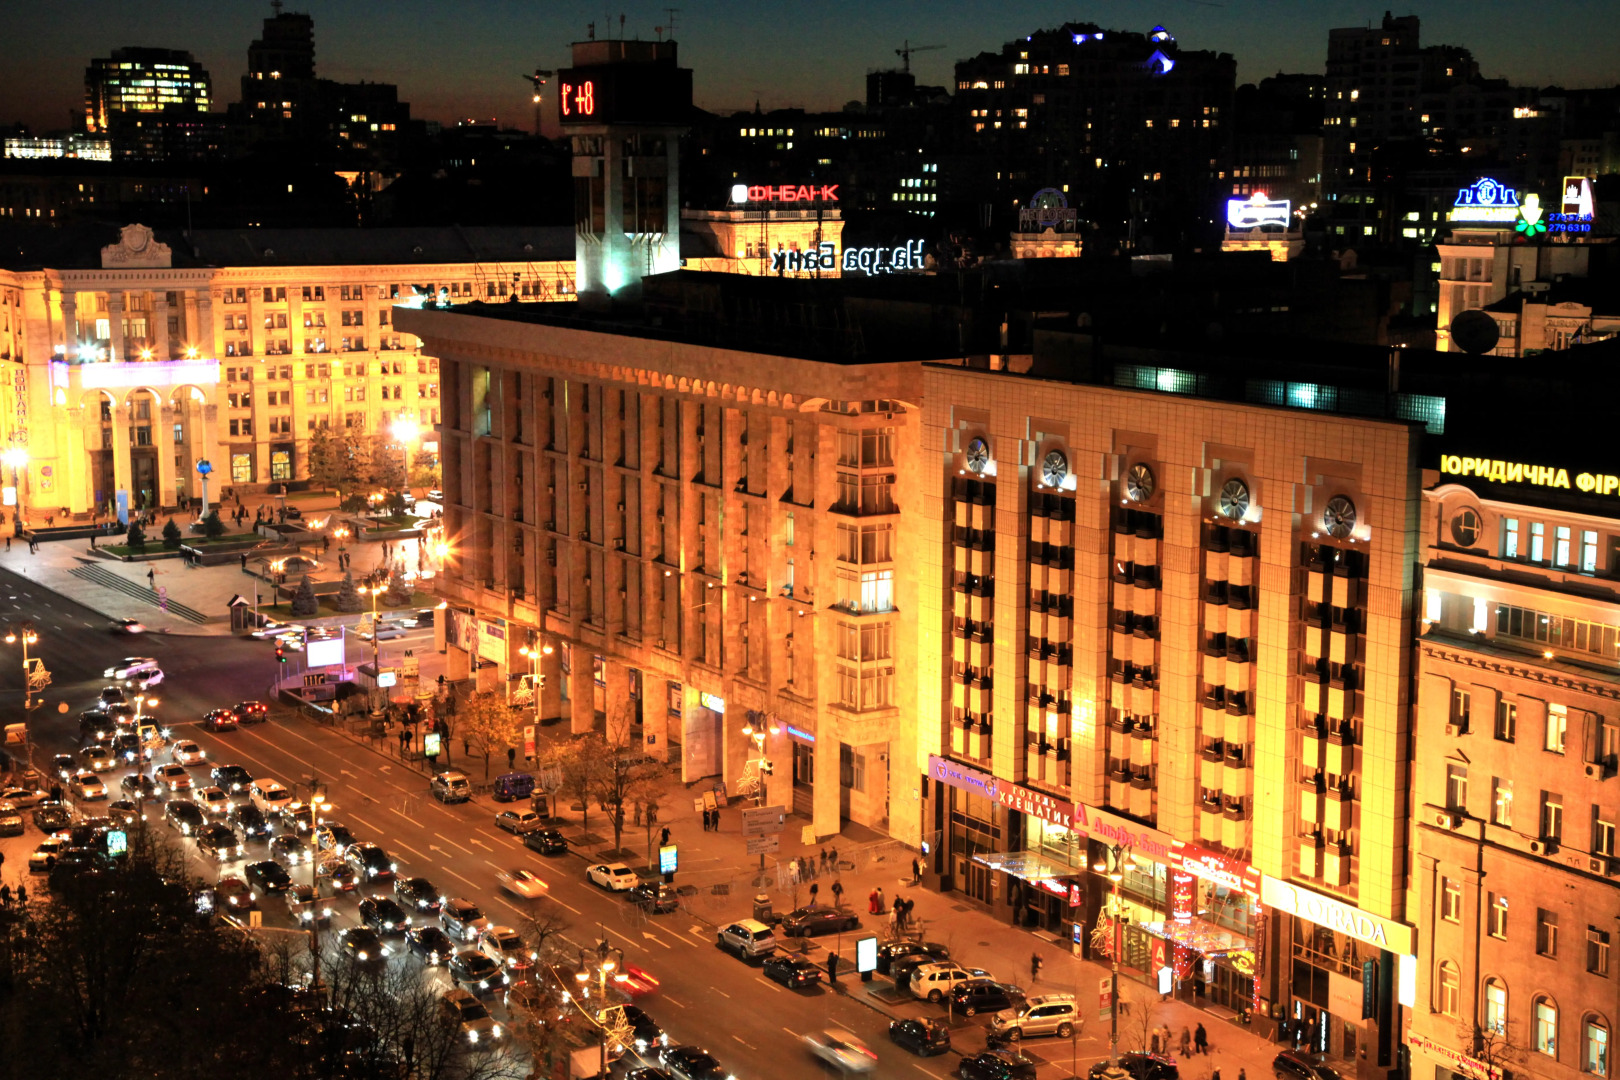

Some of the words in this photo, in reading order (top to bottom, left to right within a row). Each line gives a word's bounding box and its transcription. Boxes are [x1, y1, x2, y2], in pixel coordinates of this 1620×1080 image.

[1440, 454, 1569, 489] ЮРИДИЧНА
[1575, 471, 1620, 496] ФІР
[999, 791, 1070, 827] ХРЕЩАТИК
[1012, 786, 1057, 808] ГОТЕЛЬ
[1303, 896, 1388, 946] OTRADA
